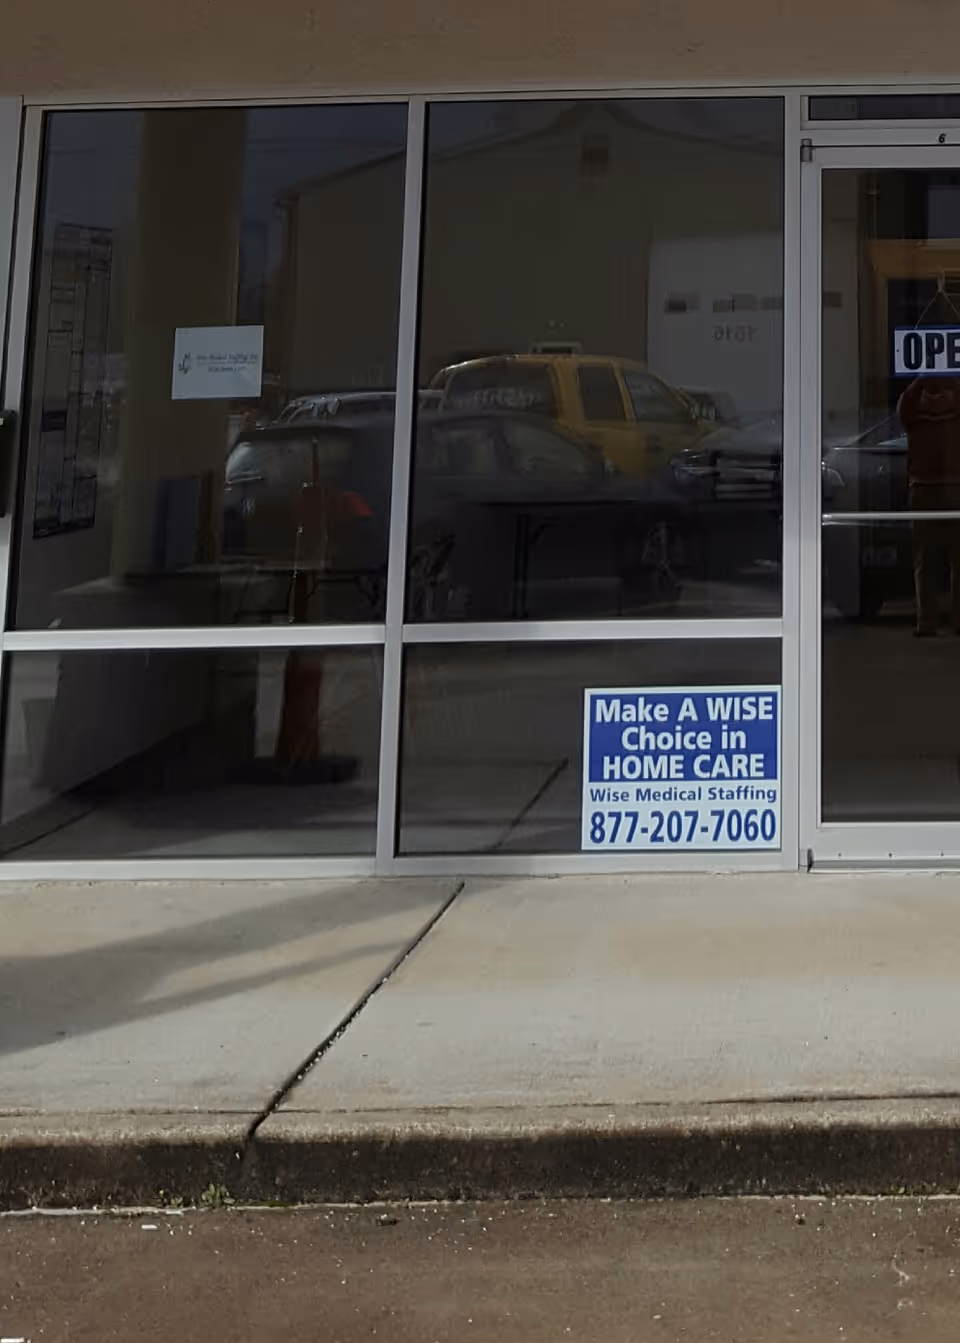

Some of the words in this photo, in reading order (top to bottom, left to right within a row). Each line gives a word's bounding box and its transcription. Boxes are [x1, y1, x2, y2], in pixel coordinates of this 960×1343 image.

[938, 132, 947, 144] 6
[595, 697, 670, 723] Make
[677, 697, 699, 722] A
[706, 696, 774, 721] WISE
[621, 725, 712, 751] Choice
[720, 724, 747, 750] in
[603, 754, 685, 780] HOME
[693, 753, 765, 779] CARE
[589, 787, 630, 802] Wise
[635, 786, 702, 802] Medical
[707, 785, 777, 803] Staffing
[589, 808, 777, 844] 877-207-7060
